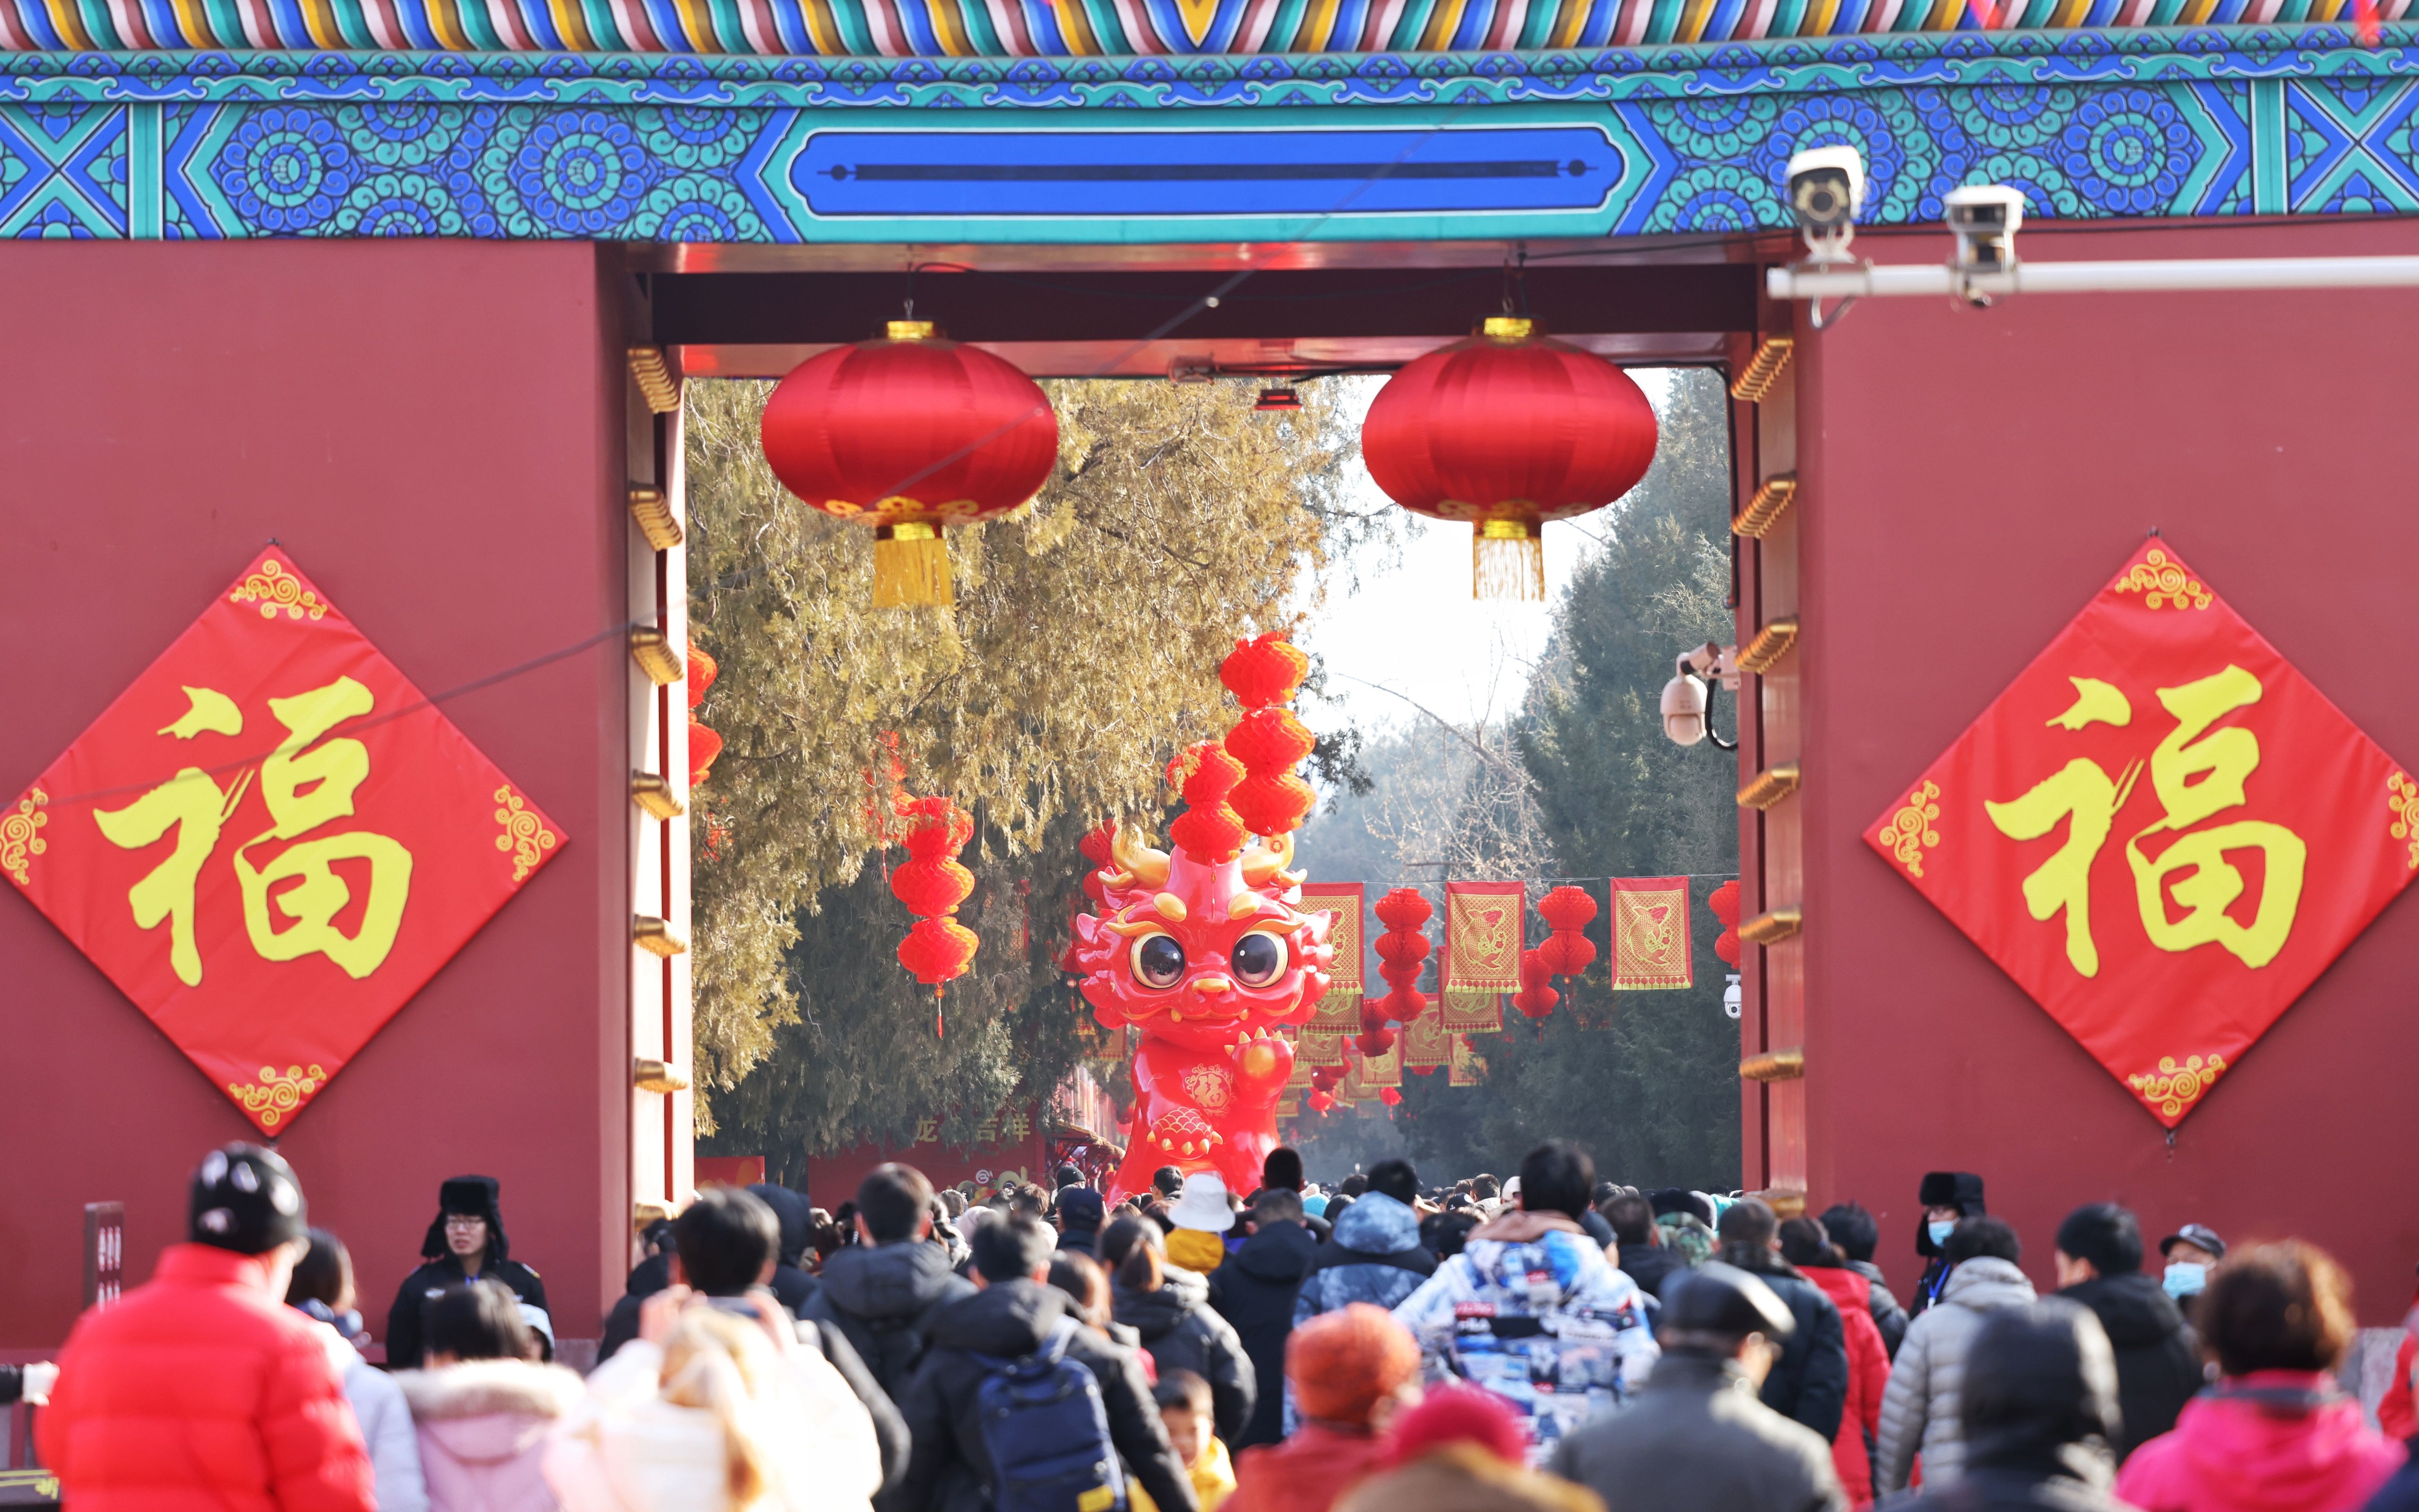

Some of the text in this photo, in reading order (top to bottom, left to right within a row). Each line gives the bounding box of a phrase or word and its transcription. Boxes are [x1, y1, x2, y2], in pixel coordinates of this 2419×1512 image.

[93, 675, 413, 987] 福
[1984, 664, 2307, 978] 福
[1194, 1073, 1228, 1108] 福
